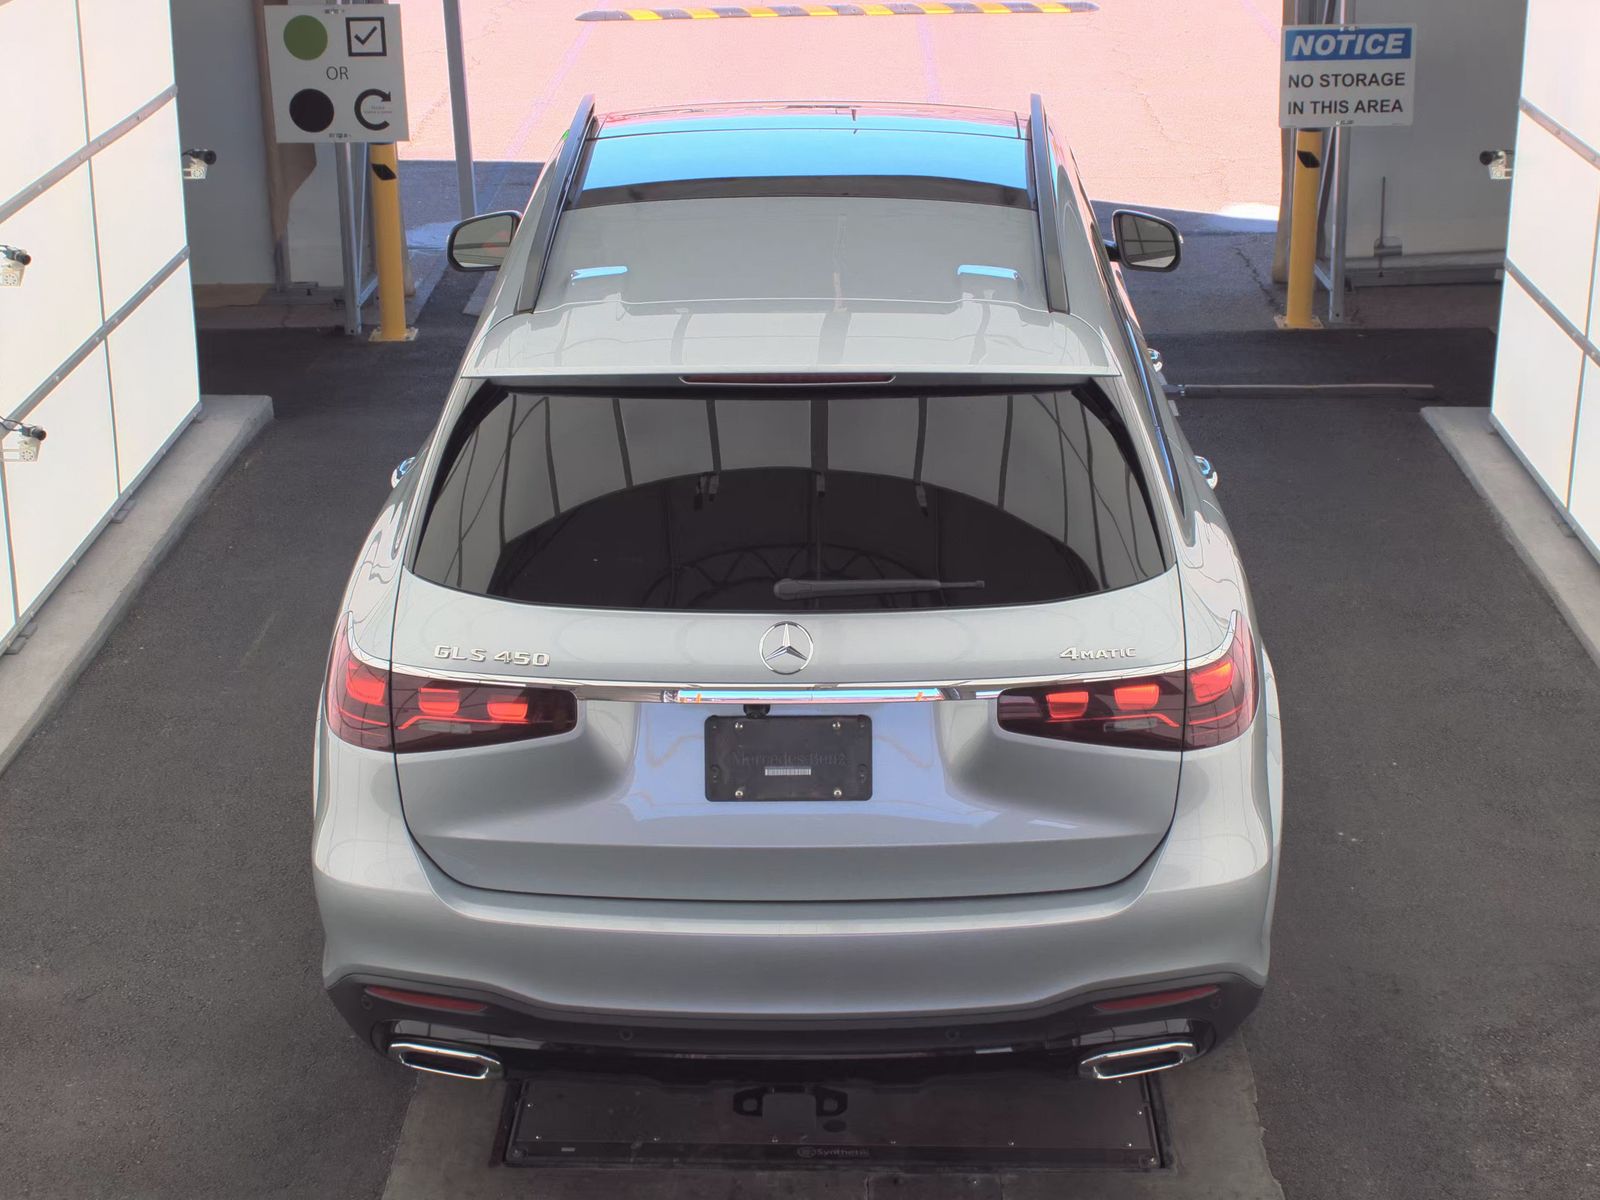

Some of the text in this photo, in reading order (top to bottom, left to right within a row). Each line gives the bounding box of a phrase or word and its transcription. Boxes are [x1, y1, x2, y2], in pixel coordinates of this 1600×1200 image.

[1291, 33, 1405, 56] NOTICE
[326, 66, 349, 80] OR
[1288, 72, 1406, 88] NO STORAGE
[1288, 99, 1403, 115] IN THIS AREA
[434, 645, 551, 667] GLS 450
[1060, 647, 1137, 661] 4MATIC
